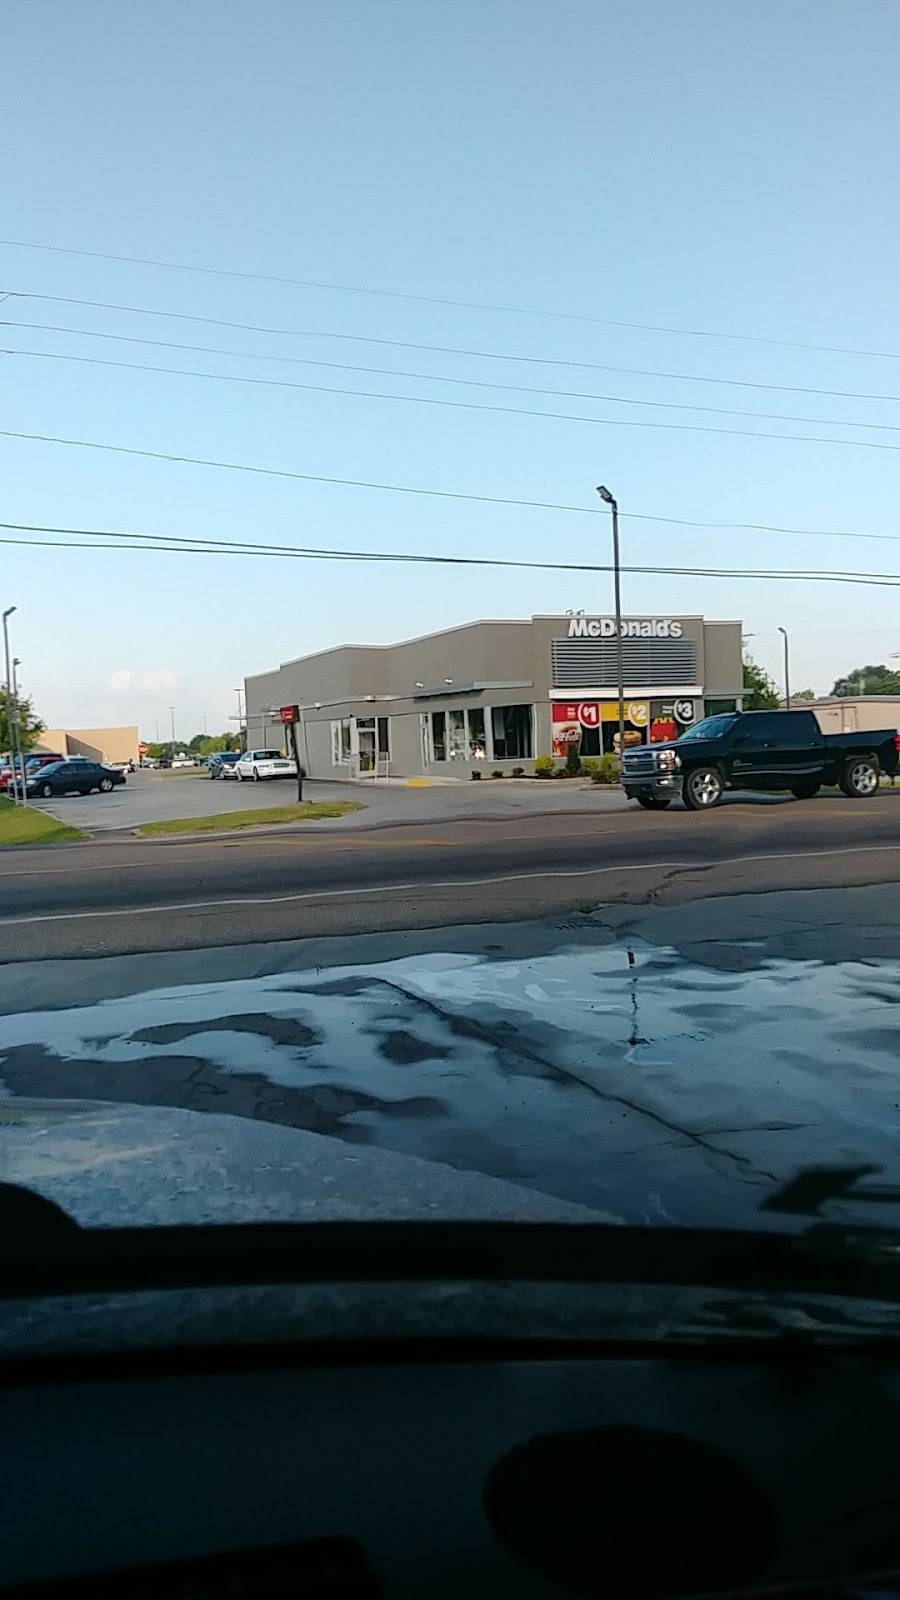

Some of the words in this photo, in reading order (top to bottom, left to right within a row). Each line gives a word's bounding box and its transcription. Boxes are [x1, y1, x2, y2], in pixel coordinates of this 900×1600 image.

[567, 618, 683, 638] McDonald's
[582, 705, 597, 723] $1
[631, 704, 647, 720] $2
[677, 702, 693, 718] $3
